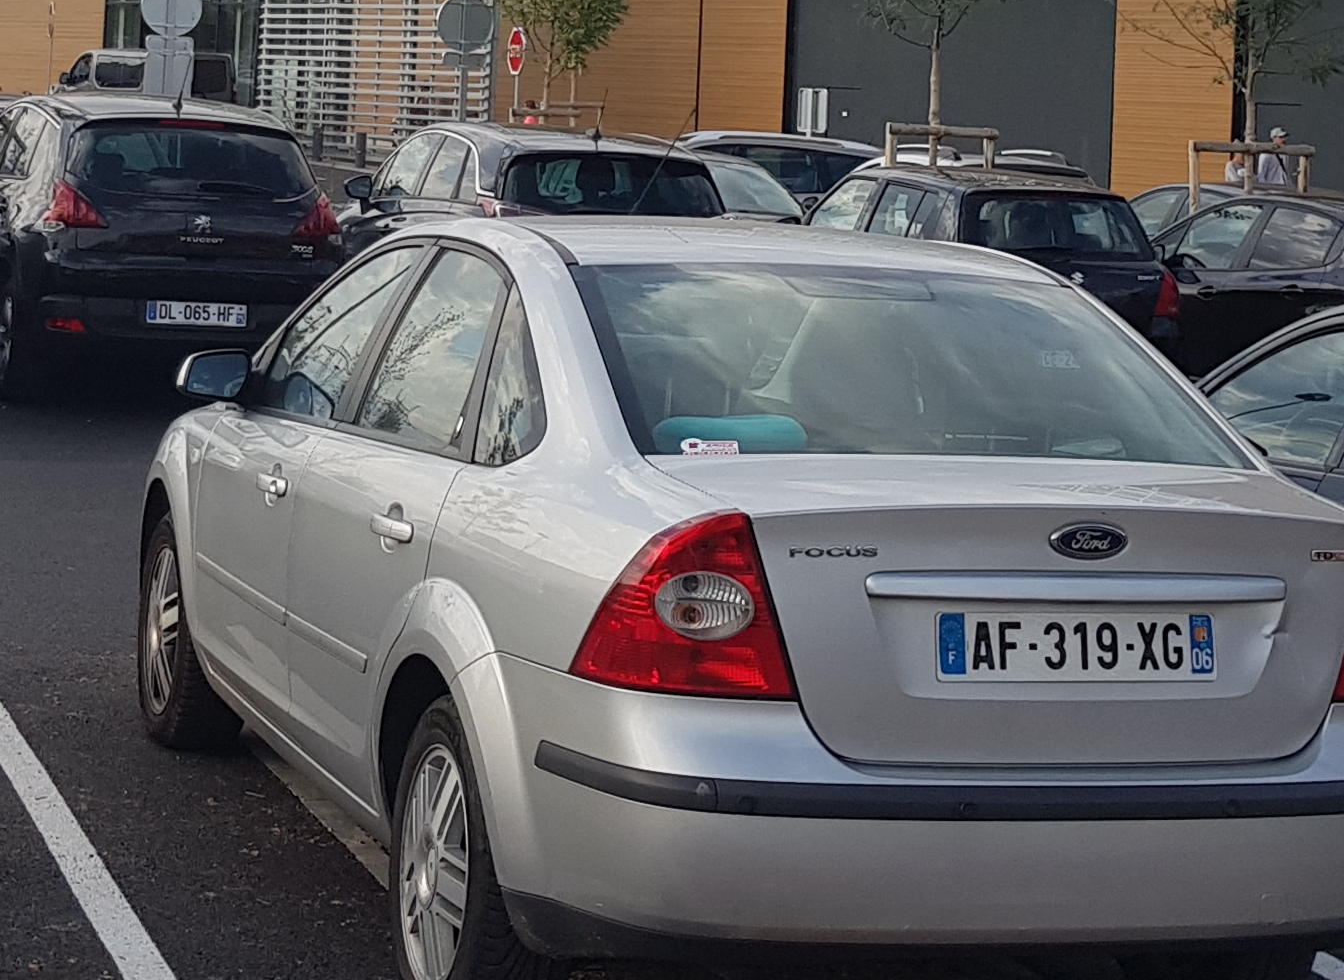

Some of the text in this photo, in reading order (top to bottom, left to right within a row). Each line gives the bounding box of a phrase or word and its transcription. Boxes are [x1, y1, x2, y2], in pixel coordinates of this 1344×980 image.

[179, 236, 225, 244] PEUGEOT
[159, 303, 236, 322] DL-065-HF
[1071, 530, 1112, 550] Ford
[789, 545, 879, 558] FOCUS
[947, 621, 1213, 671] F AF-319-XG 06
